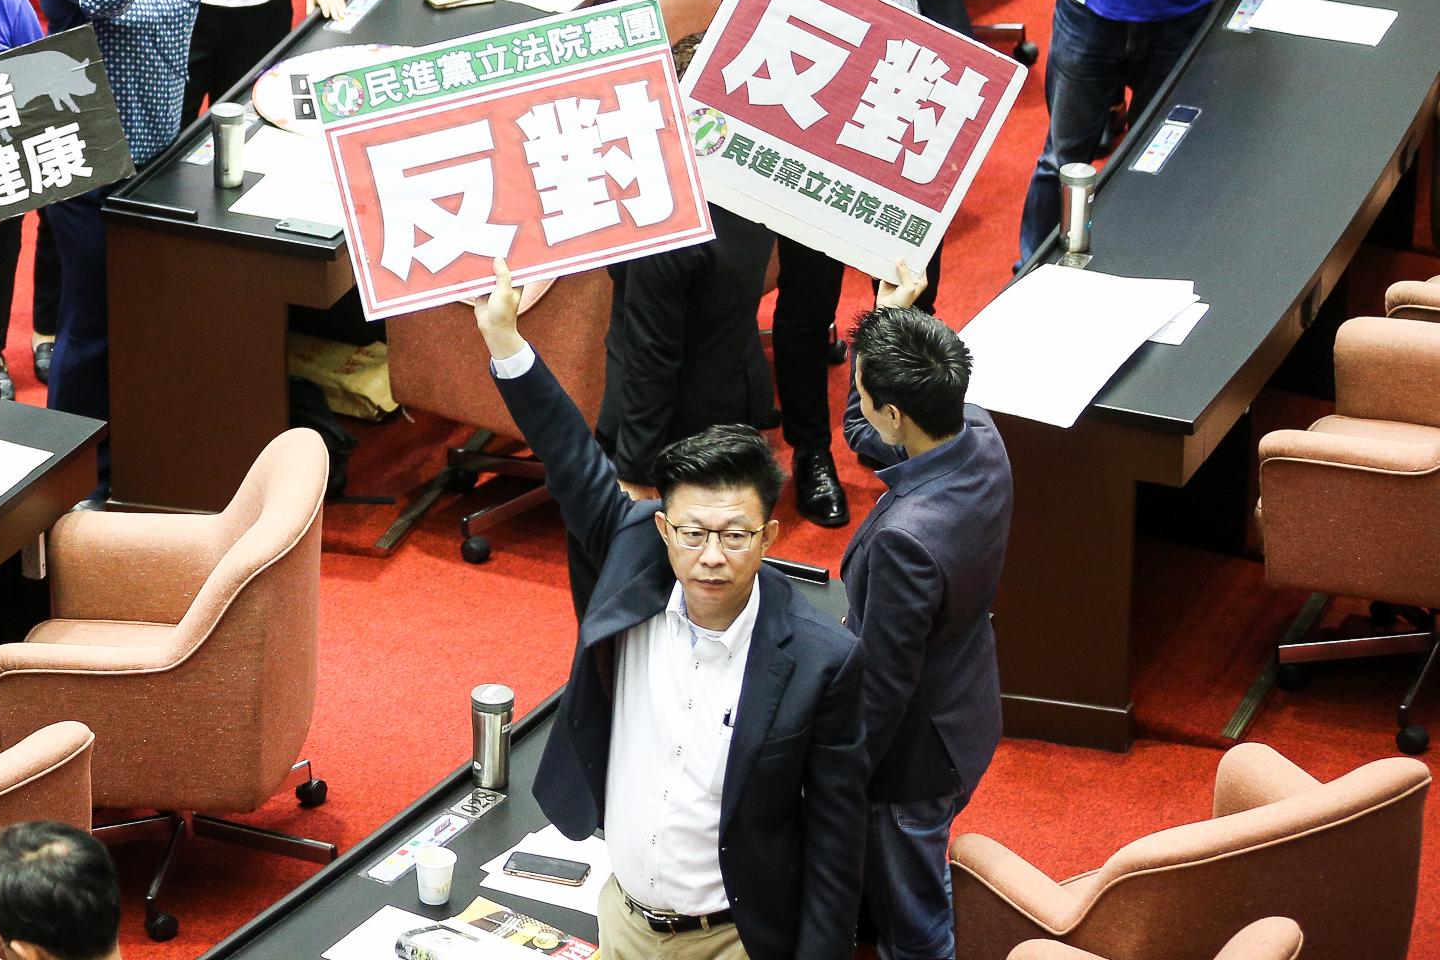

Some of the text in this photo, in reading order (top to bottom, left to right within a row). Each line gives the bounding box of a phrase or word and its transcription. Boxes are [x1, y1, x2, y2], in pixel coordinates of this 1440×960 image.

[364, 5, 663, 110] 民進黨立法院黨團
[365, 80, 676, 283] 反對
[721, 133, 933, 248] 民進黨立法院黨團
[460, 791, 497, 816] 028
